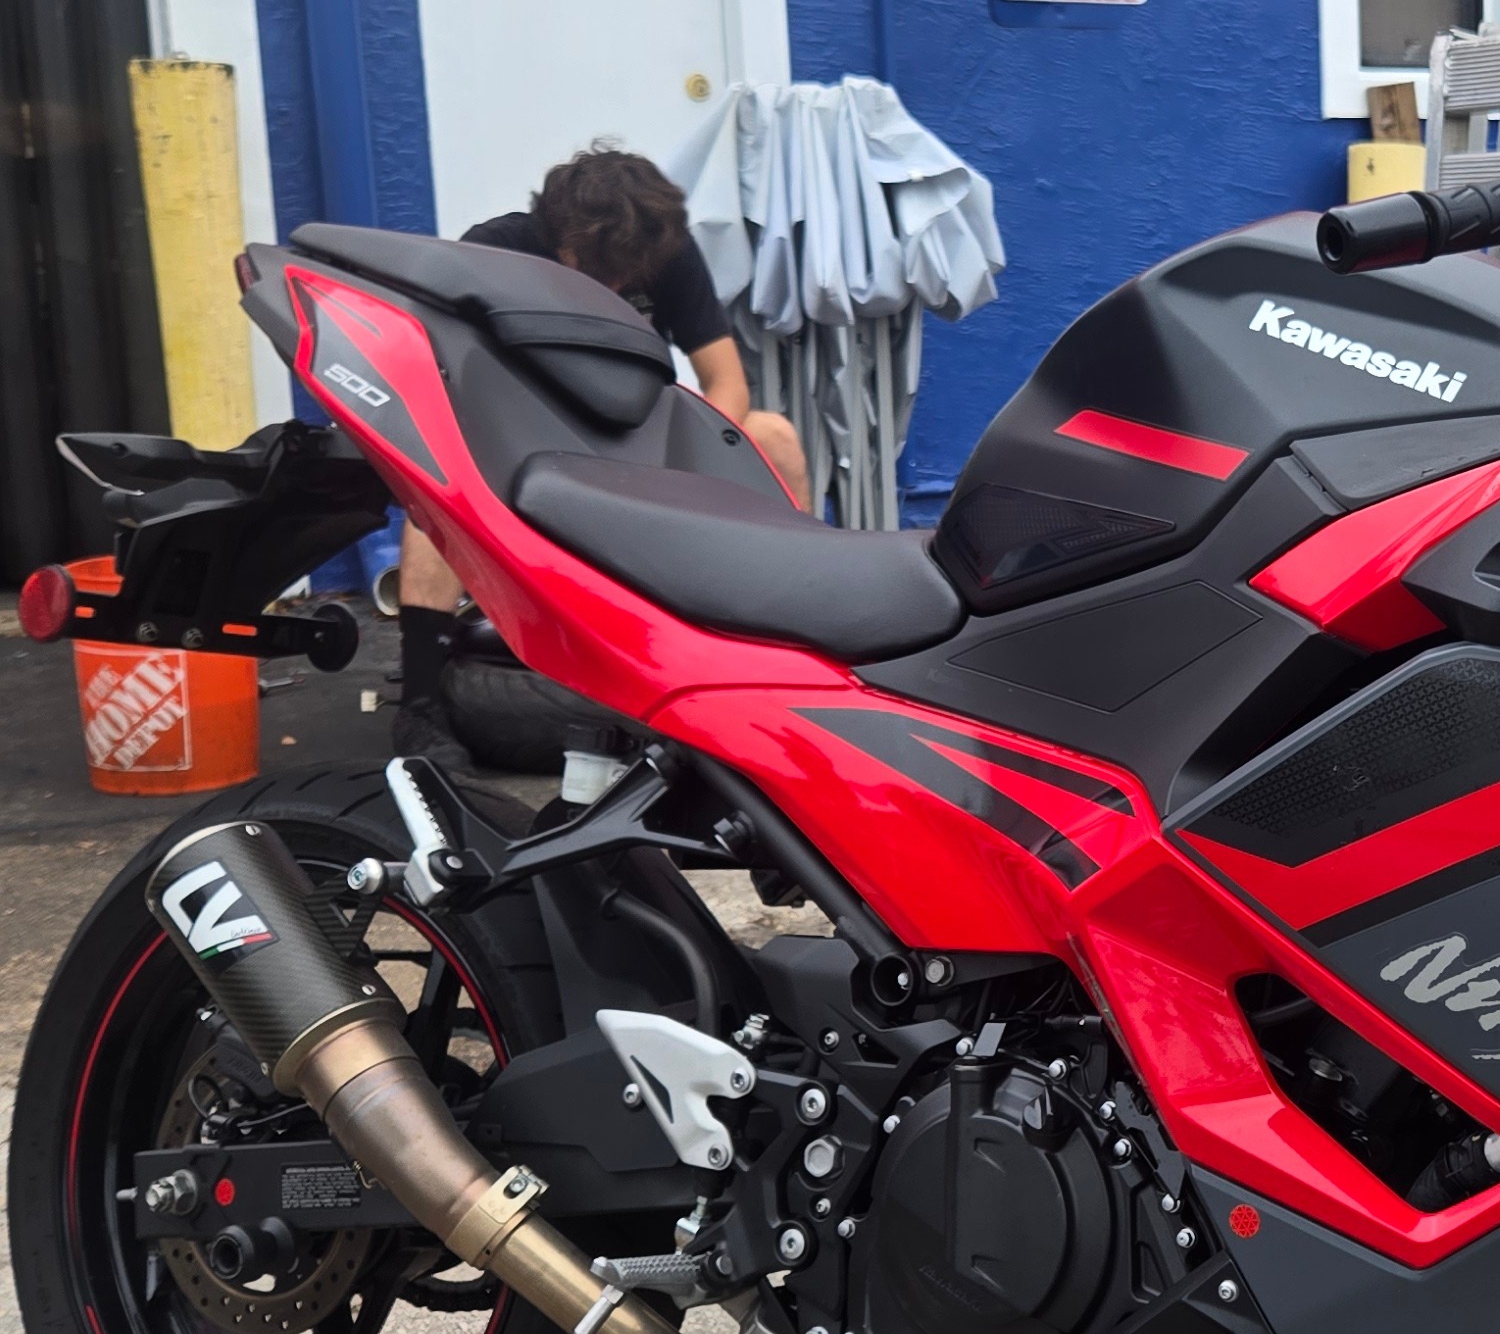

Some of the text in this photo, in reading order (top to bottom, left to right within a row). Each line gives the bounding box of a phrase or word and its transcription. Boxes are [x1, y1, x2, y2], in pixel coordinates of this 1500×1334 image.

[324, 362, 391, 407] 500
[1249, 299, 1467, 403] Kawasaki
[85, 663, 122, 711] THE
[86, 652, 185, 765] HOME
[113, 694, 188, 770] DEPOT
